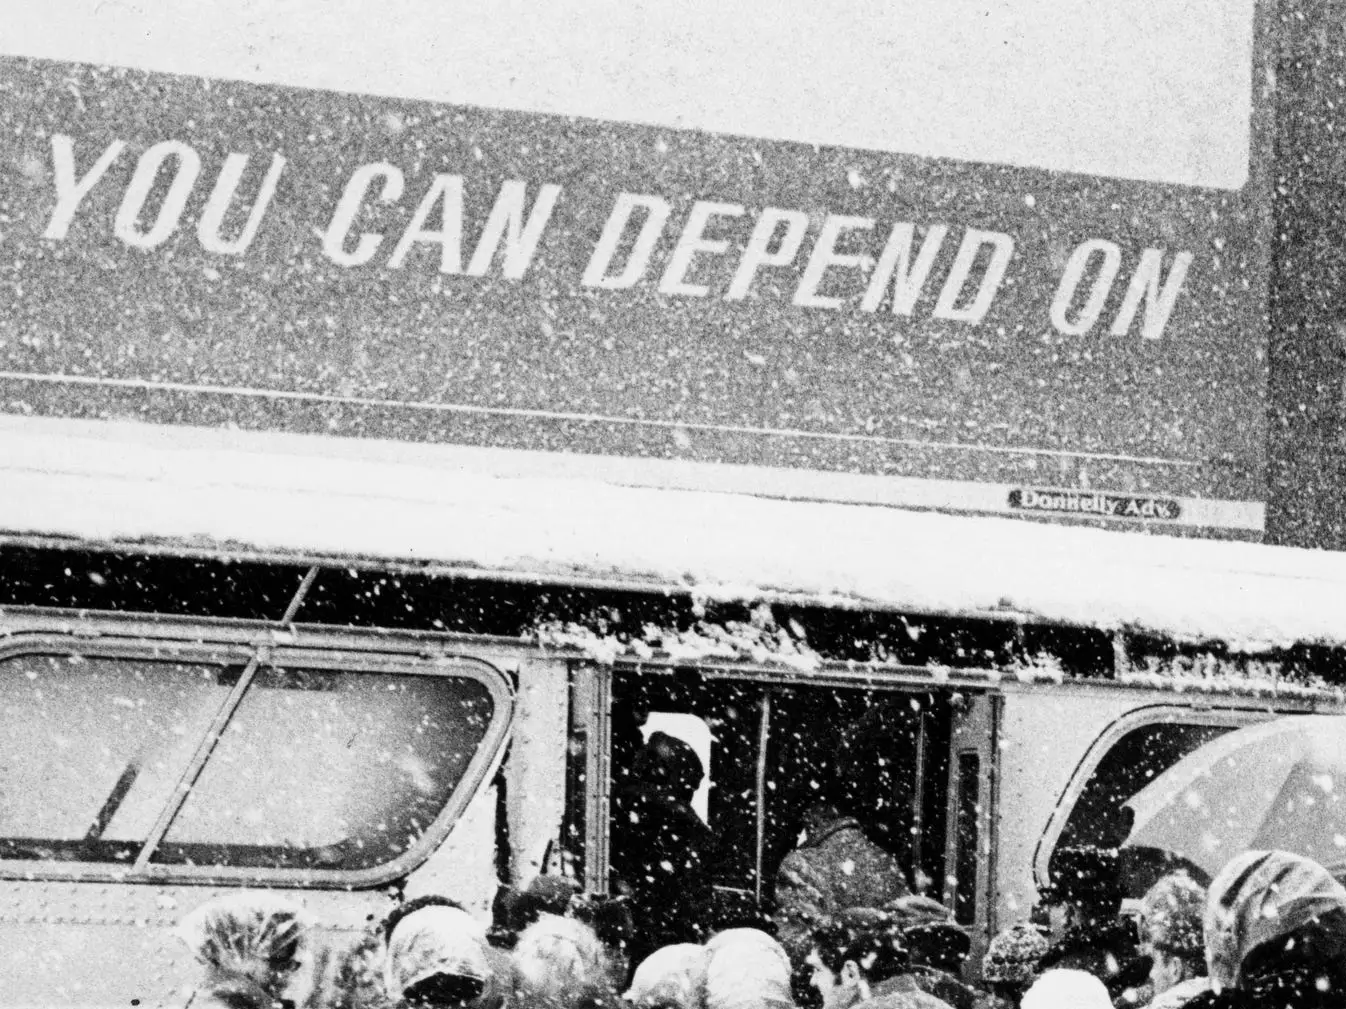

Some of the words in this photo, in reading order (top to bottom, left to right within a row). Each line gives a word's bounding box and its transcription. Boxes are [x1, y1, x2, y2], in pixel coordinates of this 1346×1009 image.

[43, 133, 286, 255] YOU
[321, 161, 562, 280] CAN
[580, 192, 1013, 325] DEPEND
[1048, 238, 1192, 340] ON
[1021, 490, 1118, 515] Donnelly
